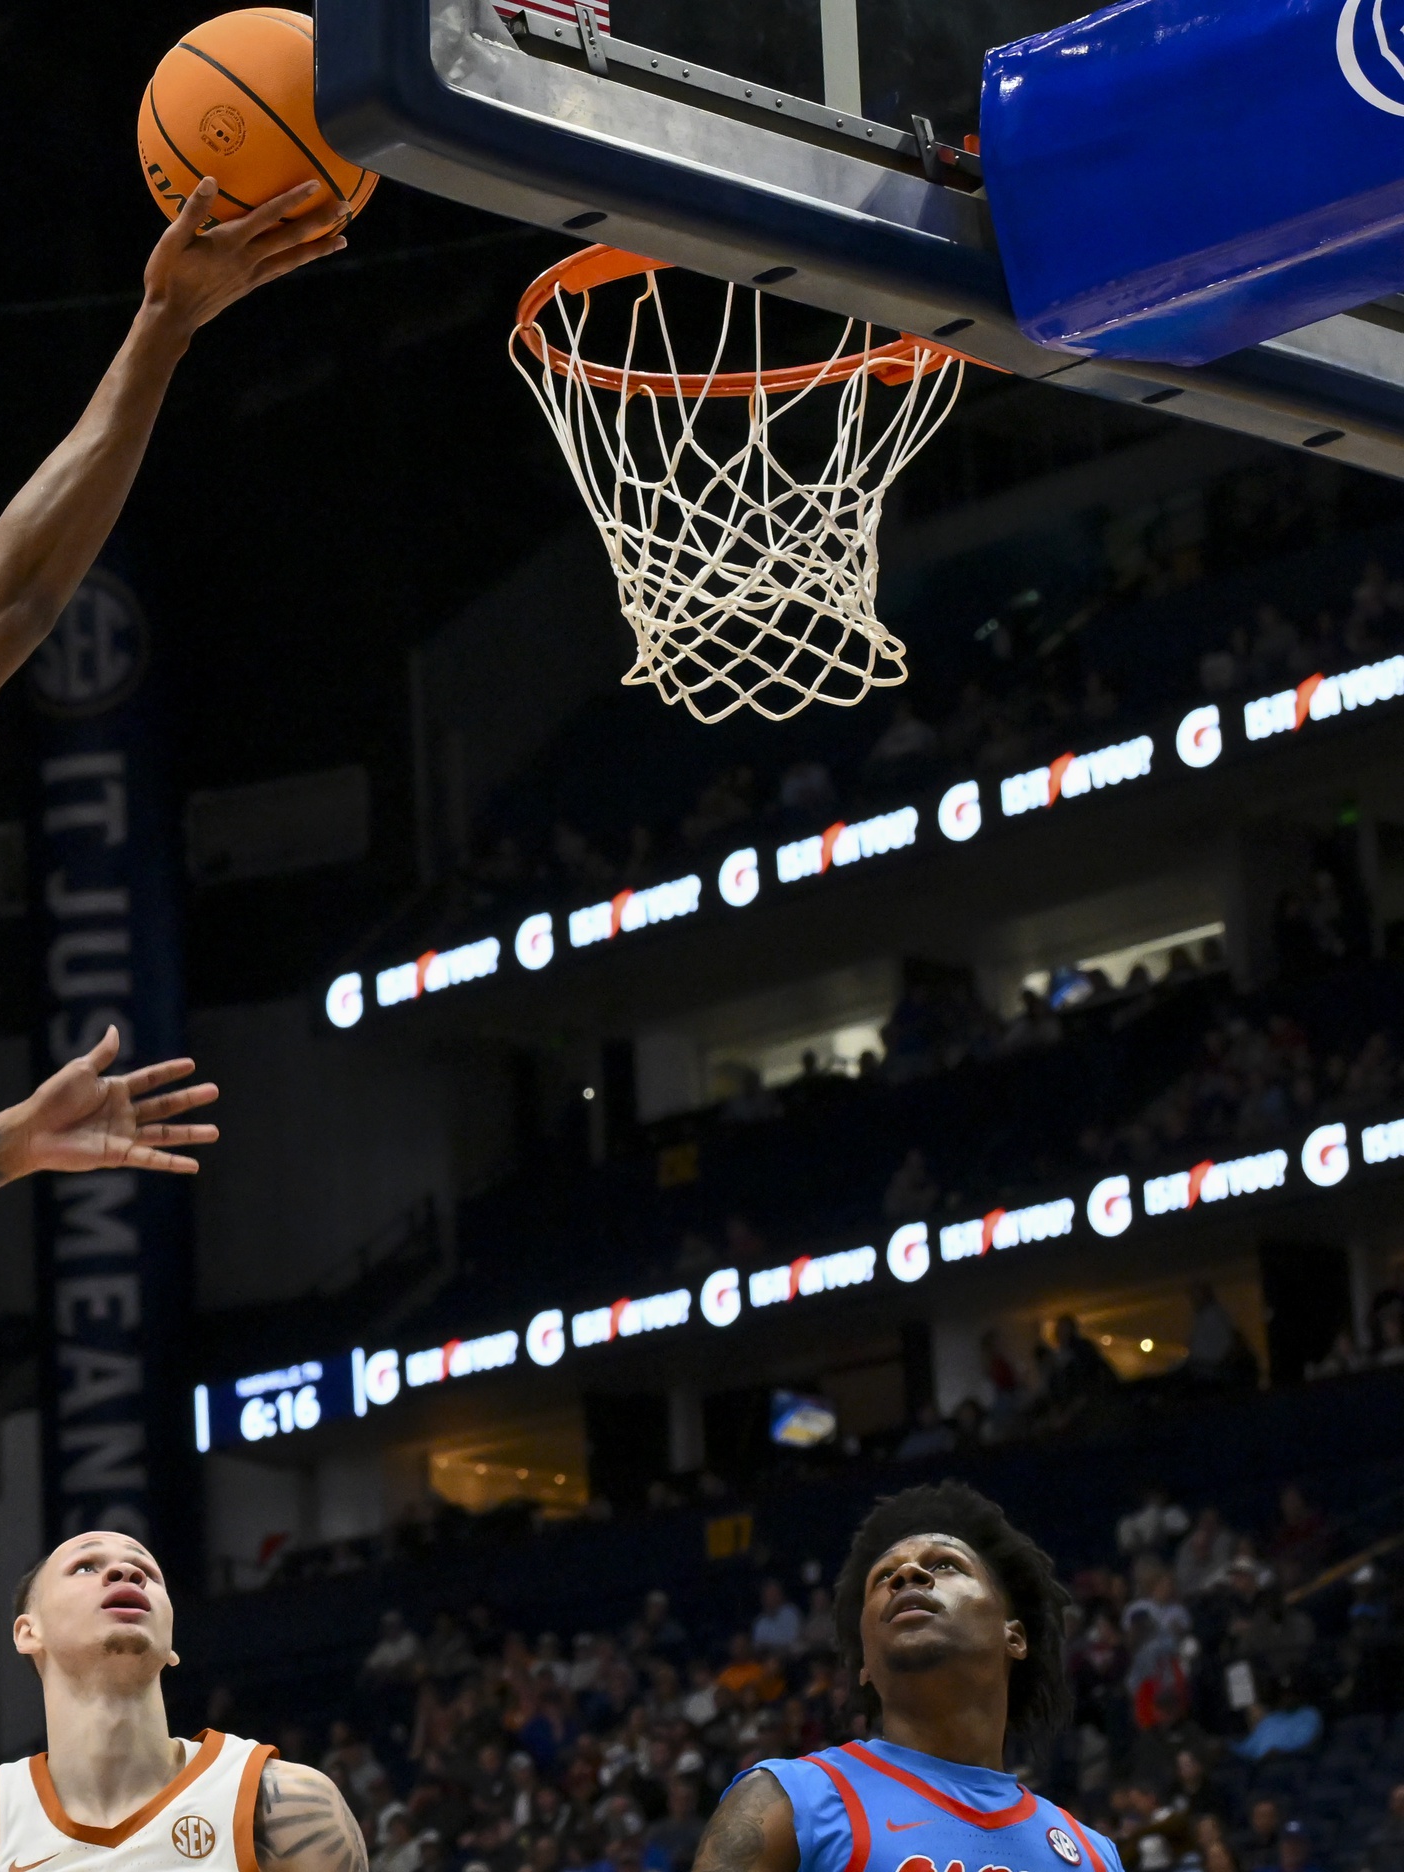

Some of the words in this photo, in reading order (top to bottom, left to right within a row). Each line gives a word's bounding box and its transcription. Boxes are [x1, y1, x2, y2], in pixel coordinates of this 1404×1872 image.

[1176, 705, 1222, 767] G
[41, 751, 127, 847] IT
[938, 780, 981, 841] G
[718, 848, 759, 906] G
[515, 913, 554, 970] G
[45, 867, 136, 1076] JUS
[326, 973, 363, 1028] G
[1301, 1123, 1349, 1186] G
[1087, 1175, 1132, 1237] G
[887, 1222, 930, 1282] G
[700, 1268, 741, 1327] G
[526, 1309, 565, 1366] G
[364, 1349, 400, 1405] G
[240, 1385, 320, 1441] 6:16
[173, 1817, 213, 1858] SEC
[1049, 1828, 1080, 1863] SEC
